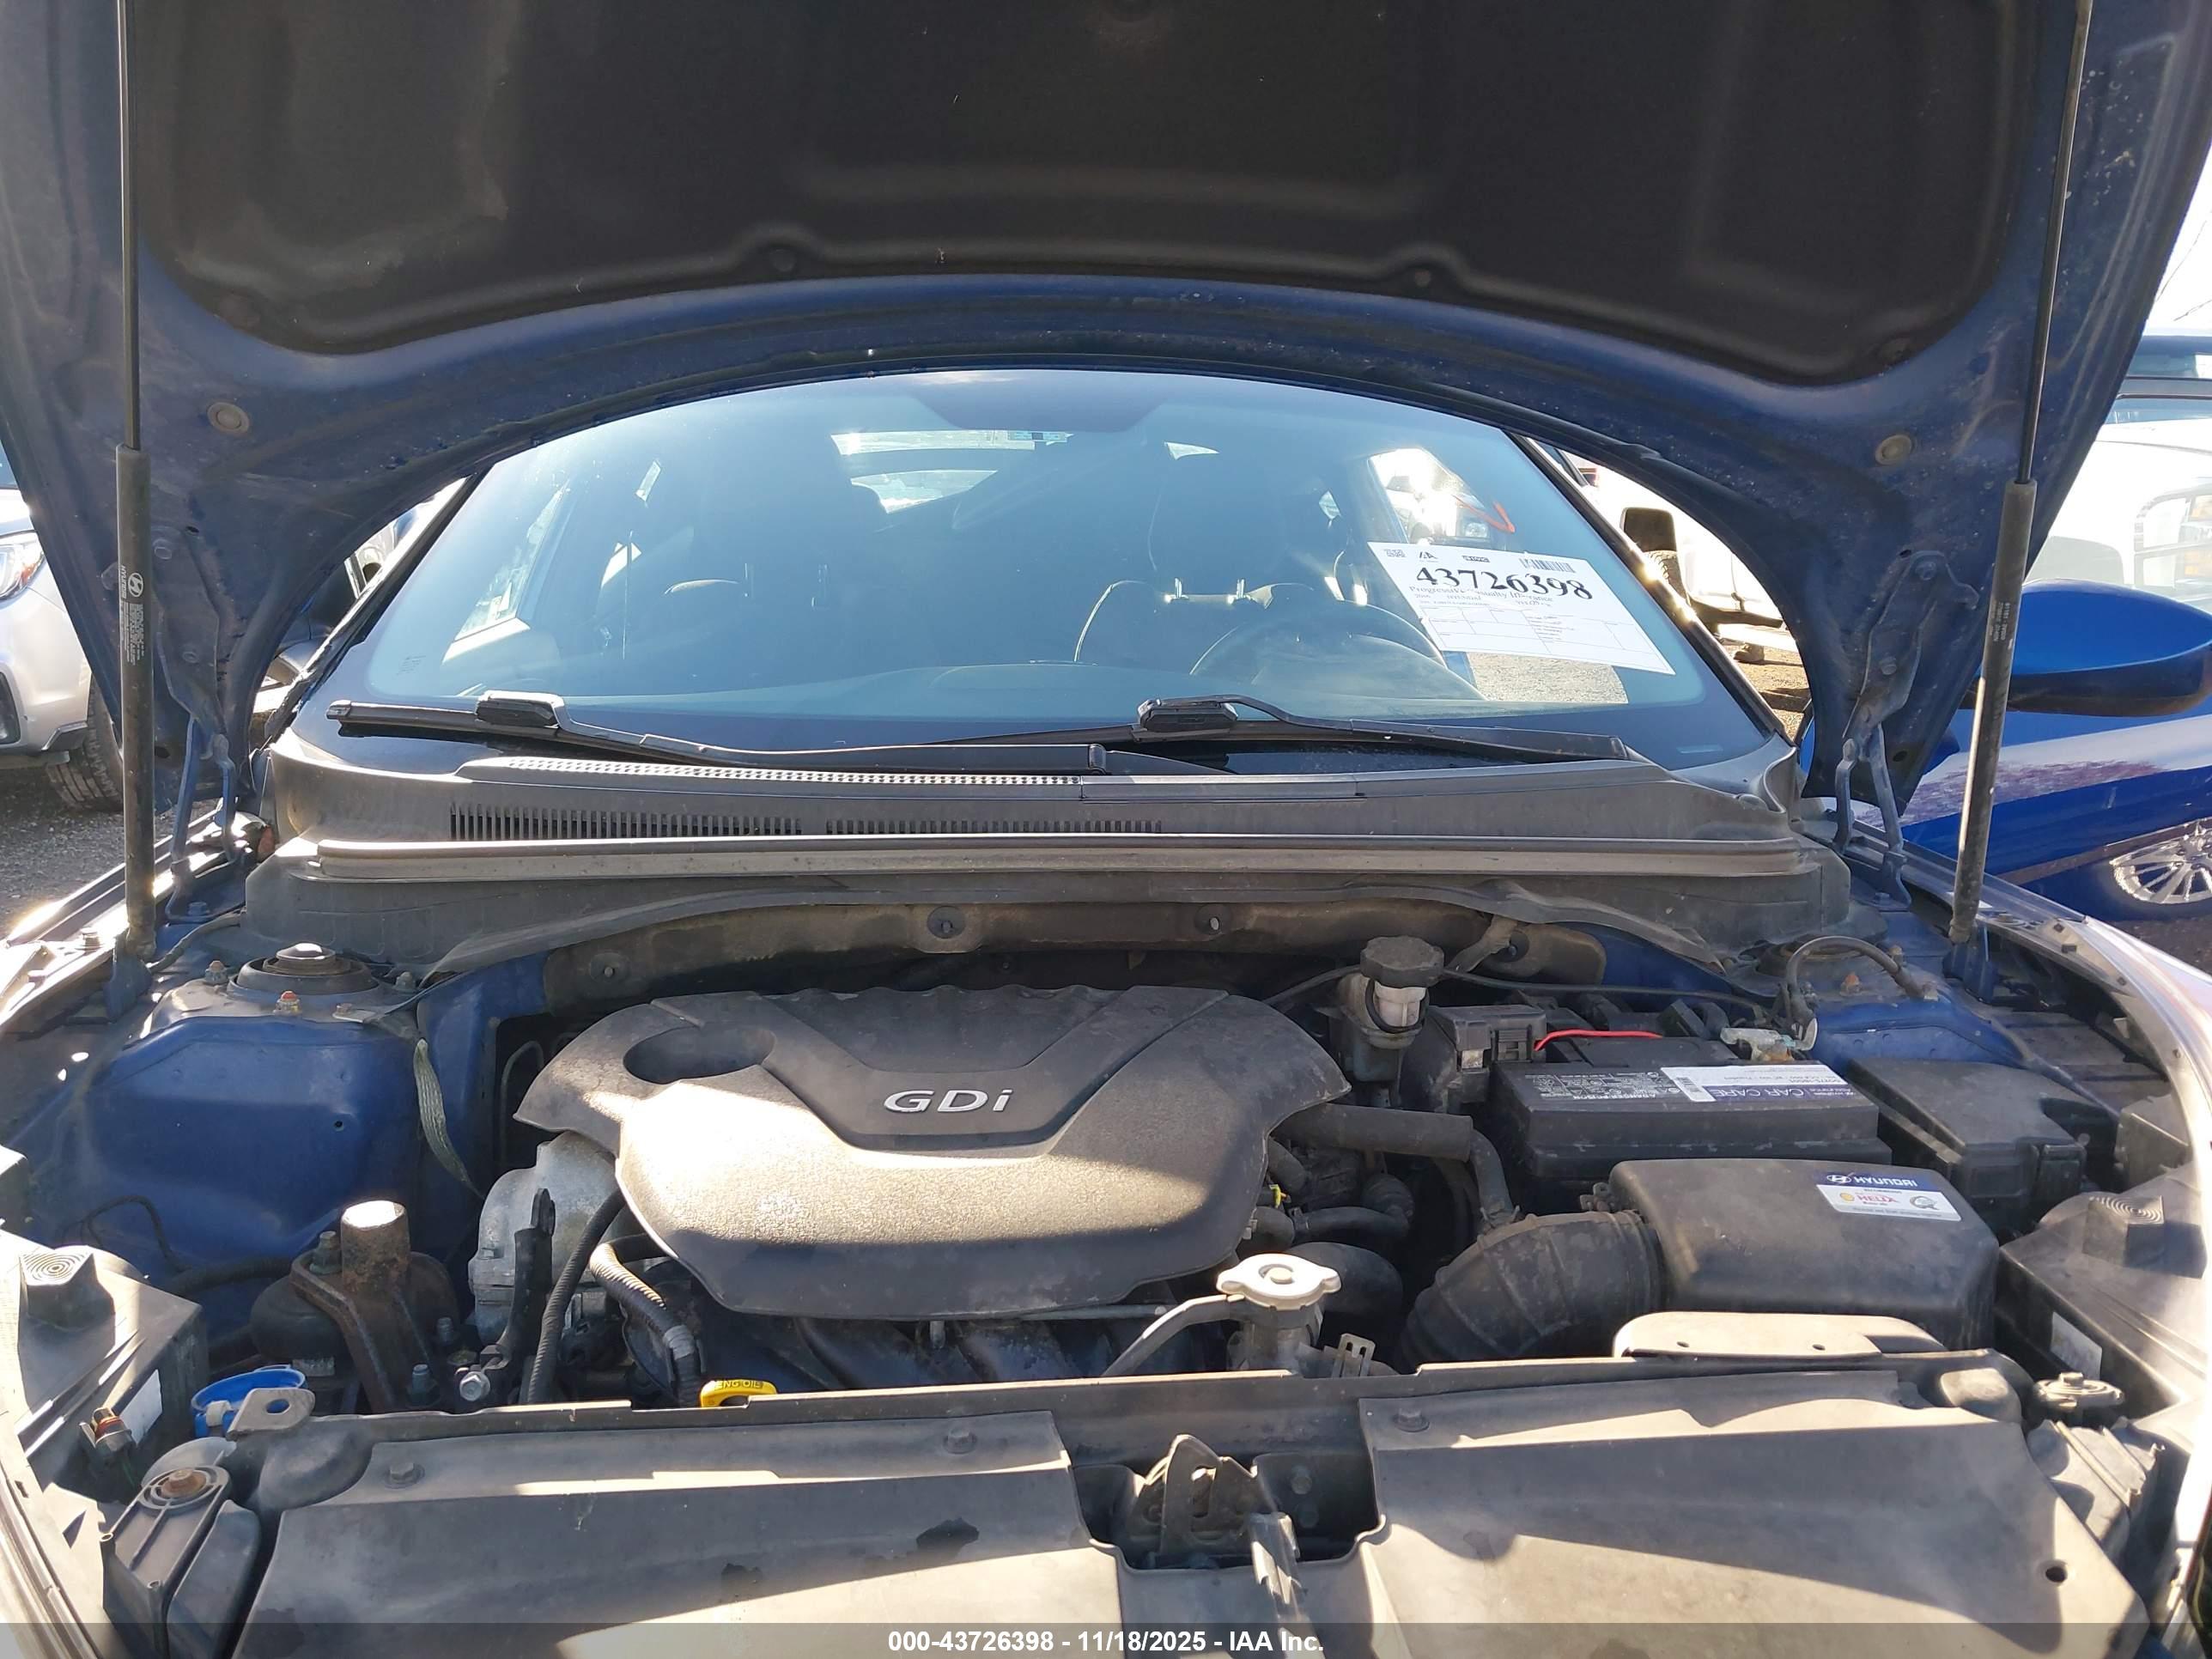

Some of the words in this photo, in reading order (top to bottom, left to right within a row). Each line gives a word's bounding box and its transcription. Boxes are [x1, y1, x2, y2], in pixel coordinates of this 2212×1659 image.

[1416, 567, 1593, 600] 43726398
[1711, 1088, 1761, 1097] CARE
[1765, 1088, 1804, 1097] CAR
[884, 1088, 1013, 1113] GDi
[1853, 1176, 1918, 1187] HYUNDAI
[714, 1380, 739, 1390] ENG
